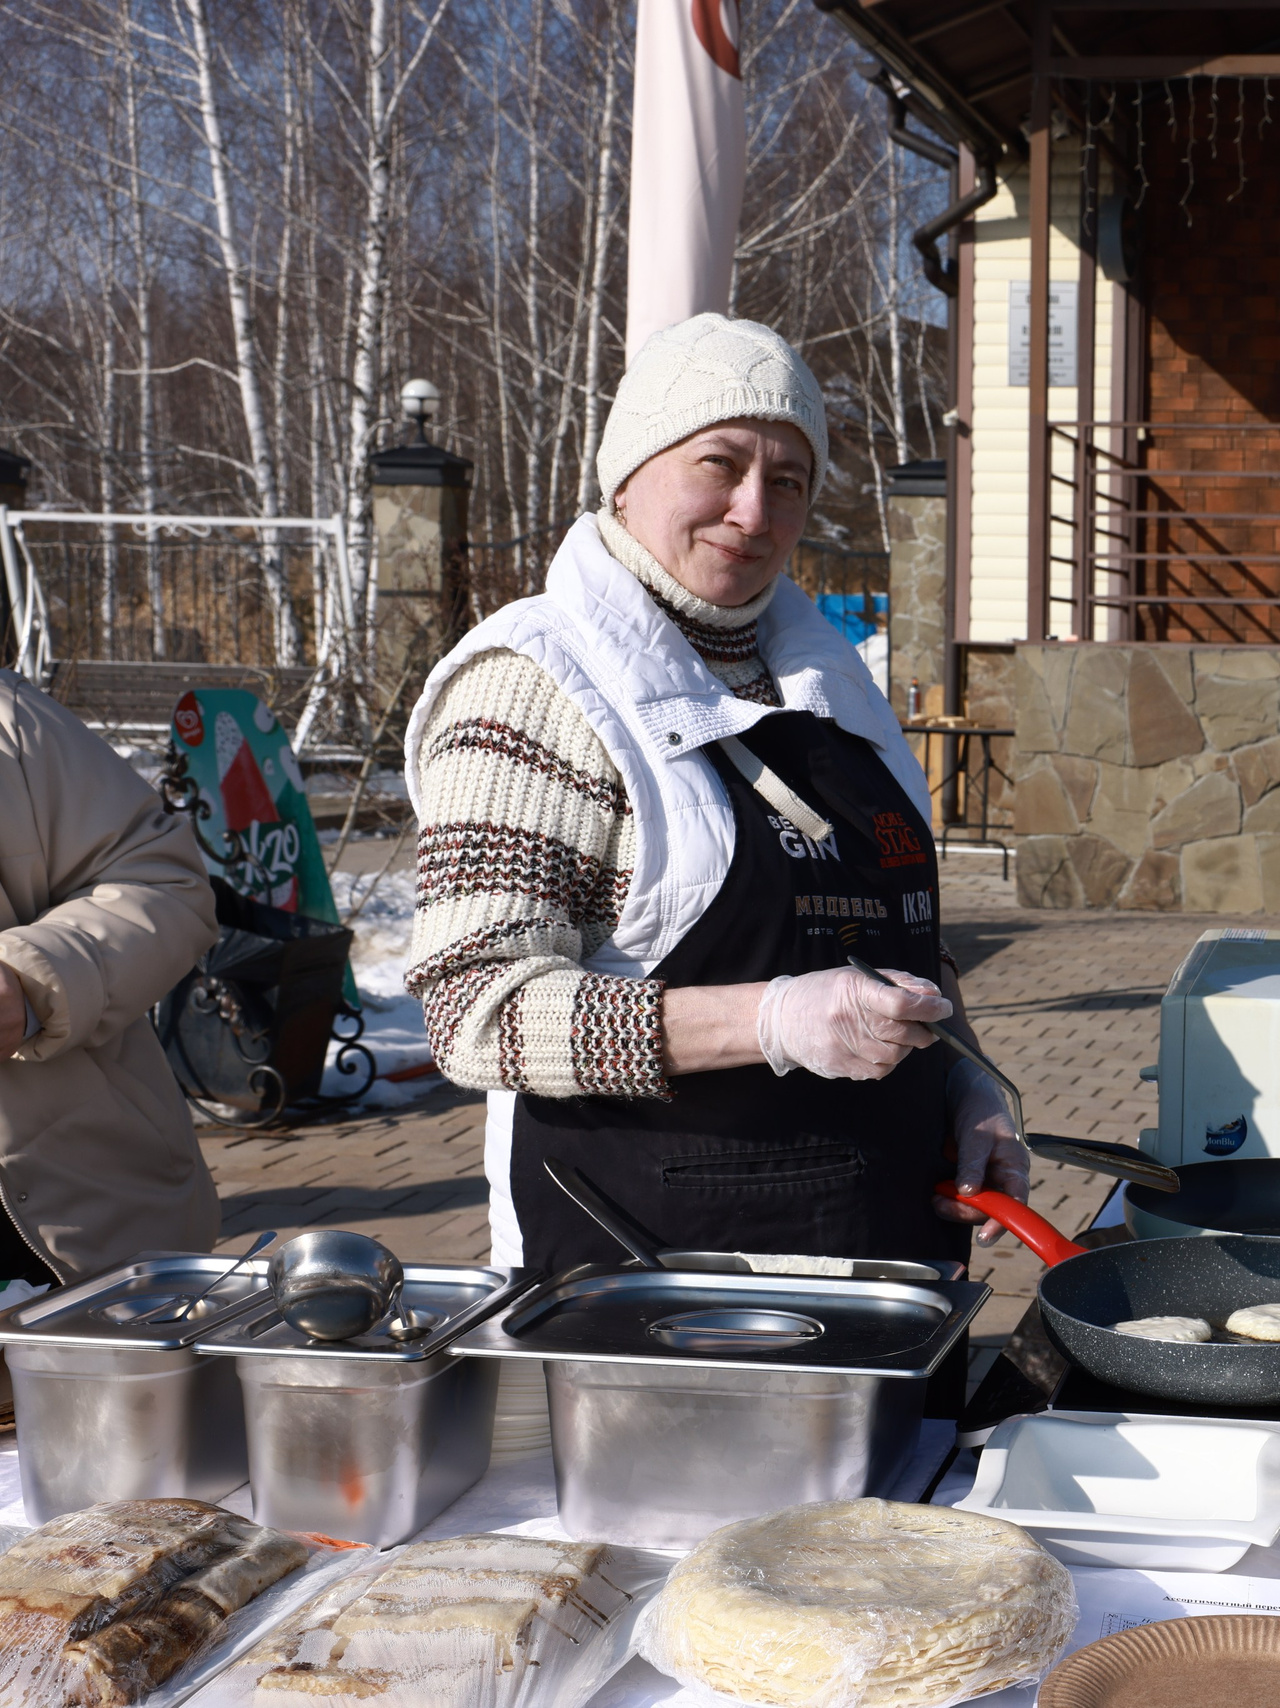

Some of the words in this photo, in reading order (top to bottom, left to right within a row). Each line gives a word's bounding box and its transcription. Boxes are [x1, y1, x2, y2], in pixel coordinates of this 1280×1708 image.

[779, 831, 841, 861] GIN
[874, 826, 921, 855] STAG
[795, 895, 888, 919] МЕДВЕДЬ
[902, 890, 933, 924] IKRA
[1162, 1595, 1252, 1609] Ассортиментный
